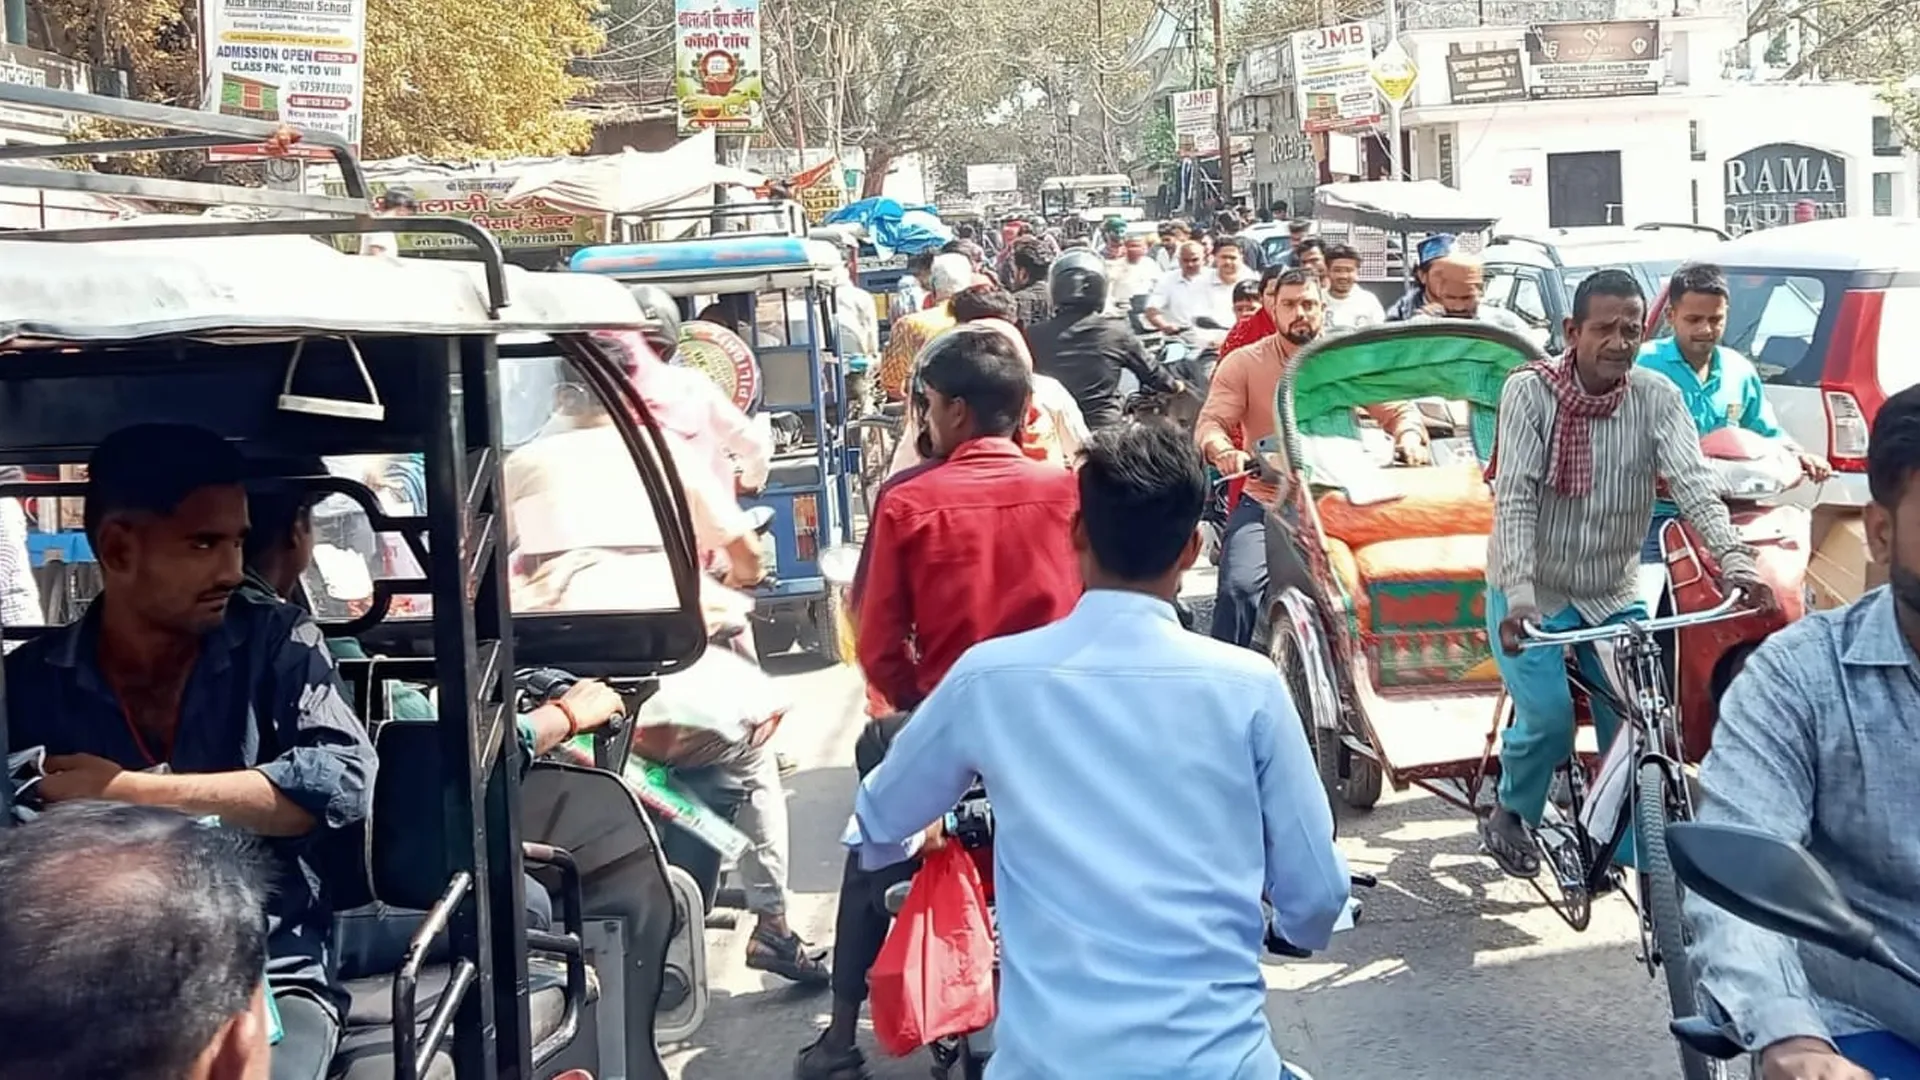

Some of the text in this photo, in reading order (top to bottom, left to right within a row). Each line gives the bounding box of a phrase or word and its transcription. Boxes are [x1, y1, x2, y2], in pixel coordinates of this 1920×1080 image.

[317, 2, 352, 13] School
[1317, 25, 1364, 50] JMB
[216, 45, 279, 60] ADMISSION
[281, 48, 313, 62] OPEN
[231, 61, 263, 72] CLASS
[290, 64, 305, 75] NC
[307, 66, 321, 76] TO
[1726, 156, 1837, 196] RAMA
